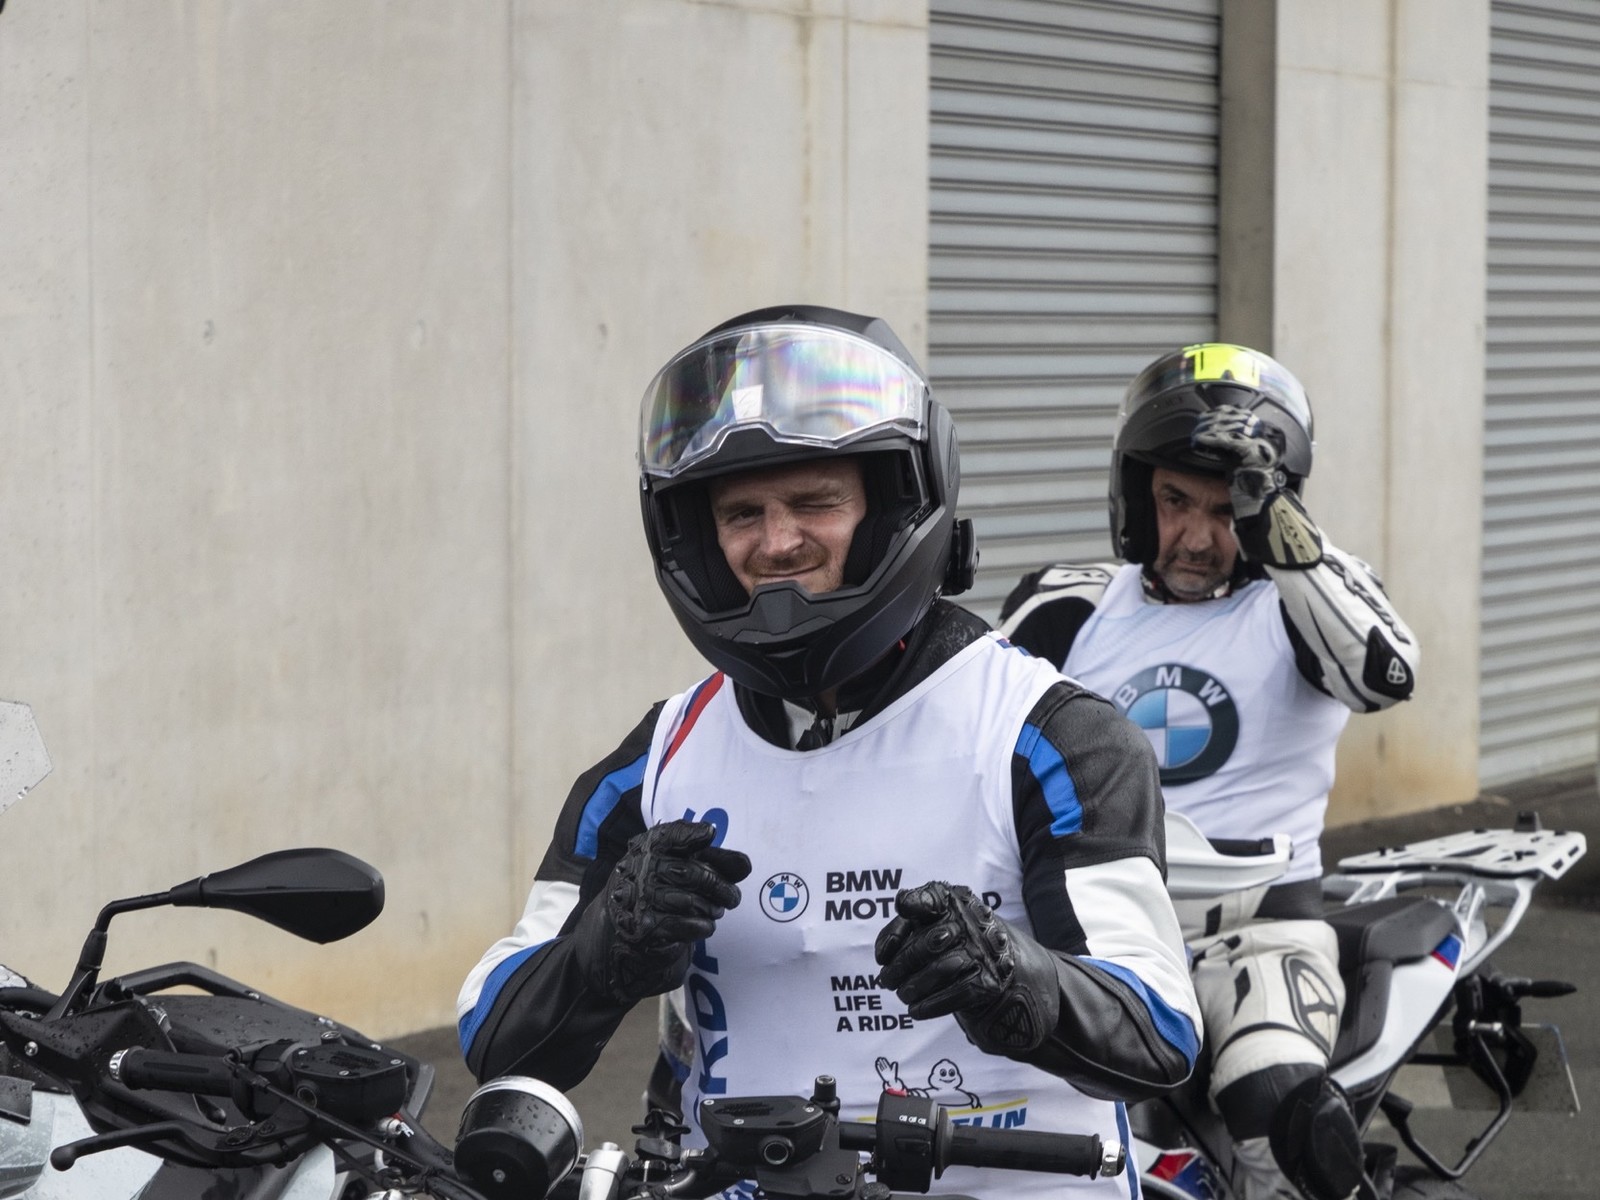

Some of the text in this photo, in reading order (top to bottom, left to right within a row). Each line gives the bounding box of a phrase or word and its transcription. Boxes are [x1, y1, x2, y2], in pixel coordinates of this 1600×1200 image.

[1115, 665, 1228, 707] BMW
[767, 875, 803, 889] BMW
[826, 869, 902, 893] BMW
[825, 891, 1002, 921] MOTD
[831, 974, 882, 991] MAK
[834, 995, 882, 1012] LIFE
[836, 1014, 914, 1032] A RIDE
